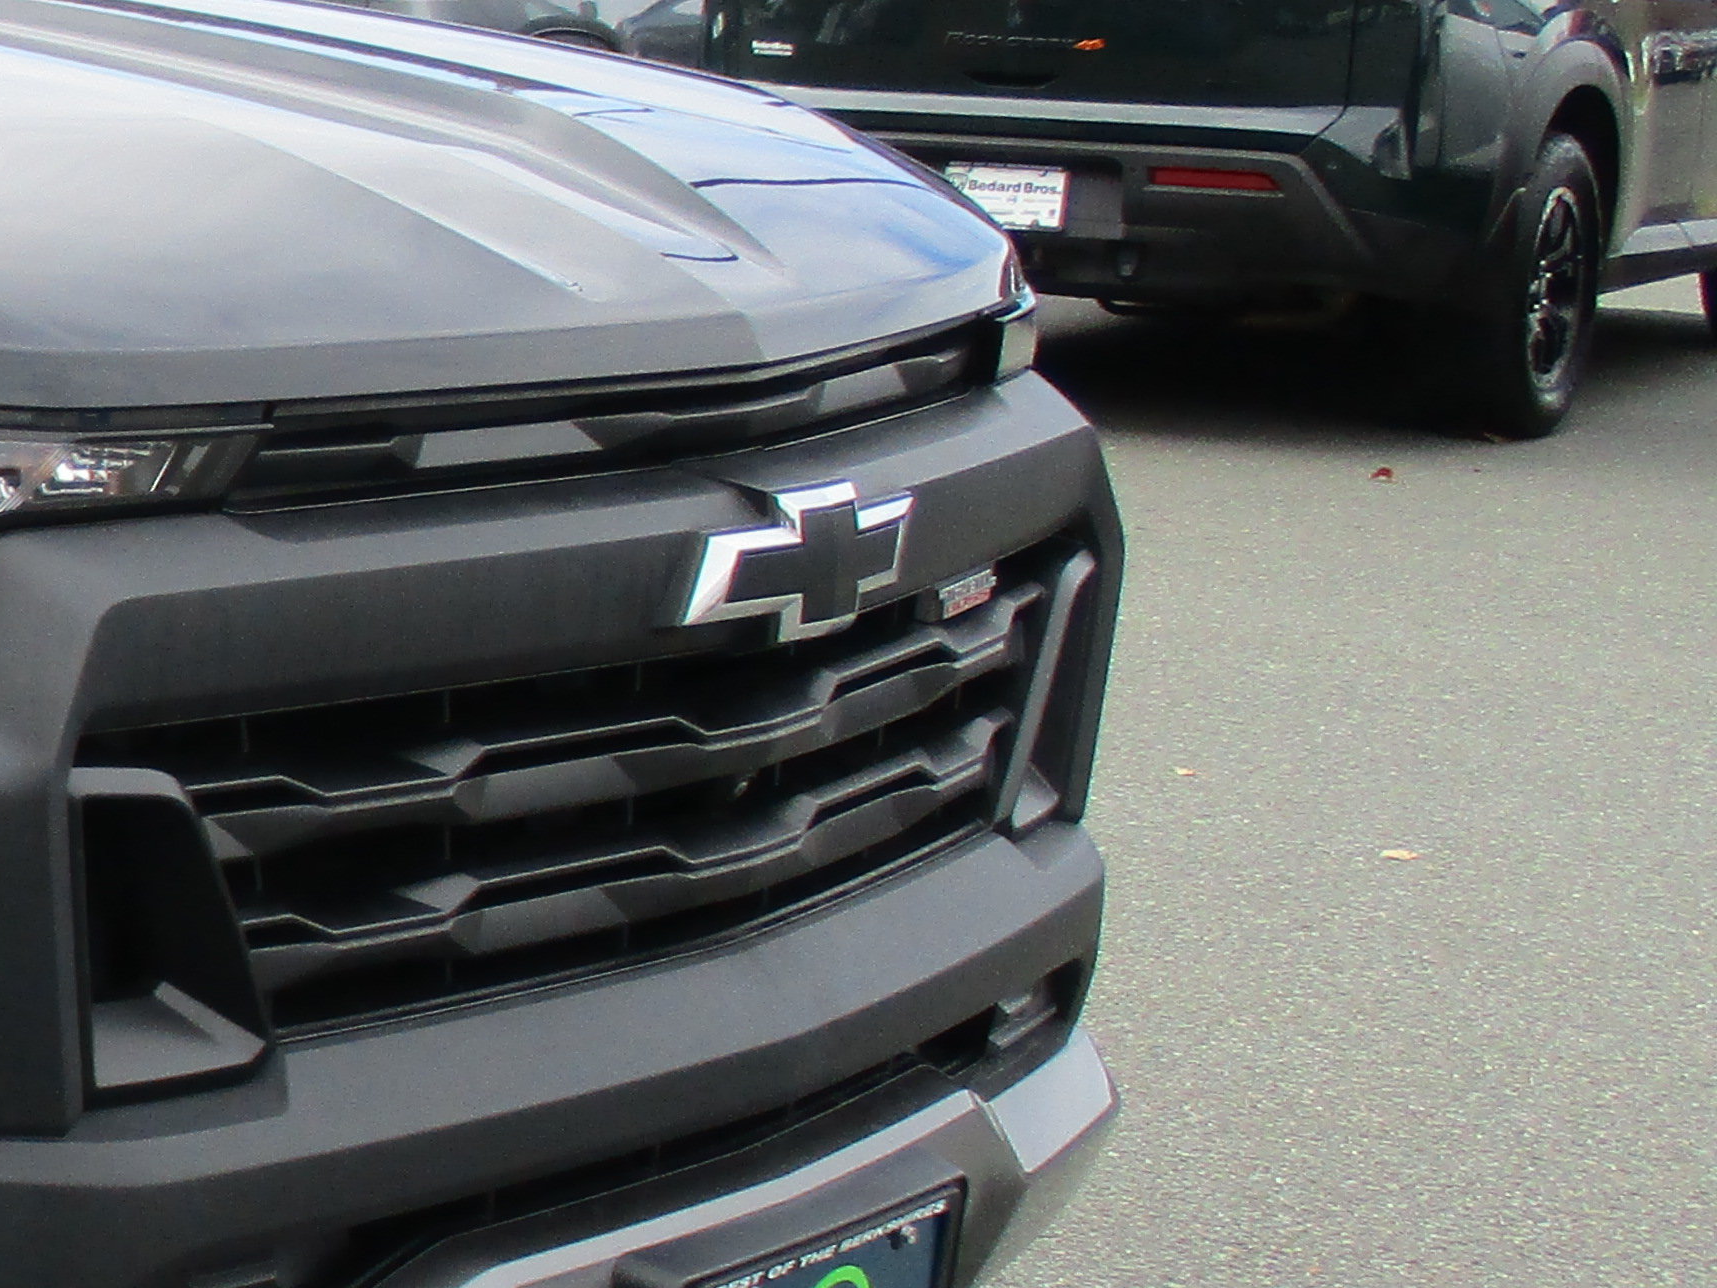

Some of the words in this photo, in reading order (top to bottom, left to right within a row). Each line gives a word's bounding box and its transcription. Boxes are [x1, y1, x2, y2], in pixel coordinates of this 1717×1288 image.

[968, 179, 1022, 193] Bedard
[1023, 182, 1062, 195] Bros.
[767, 1259, 798, 1280] OF
[799, 1244, 837, 1268] THE
